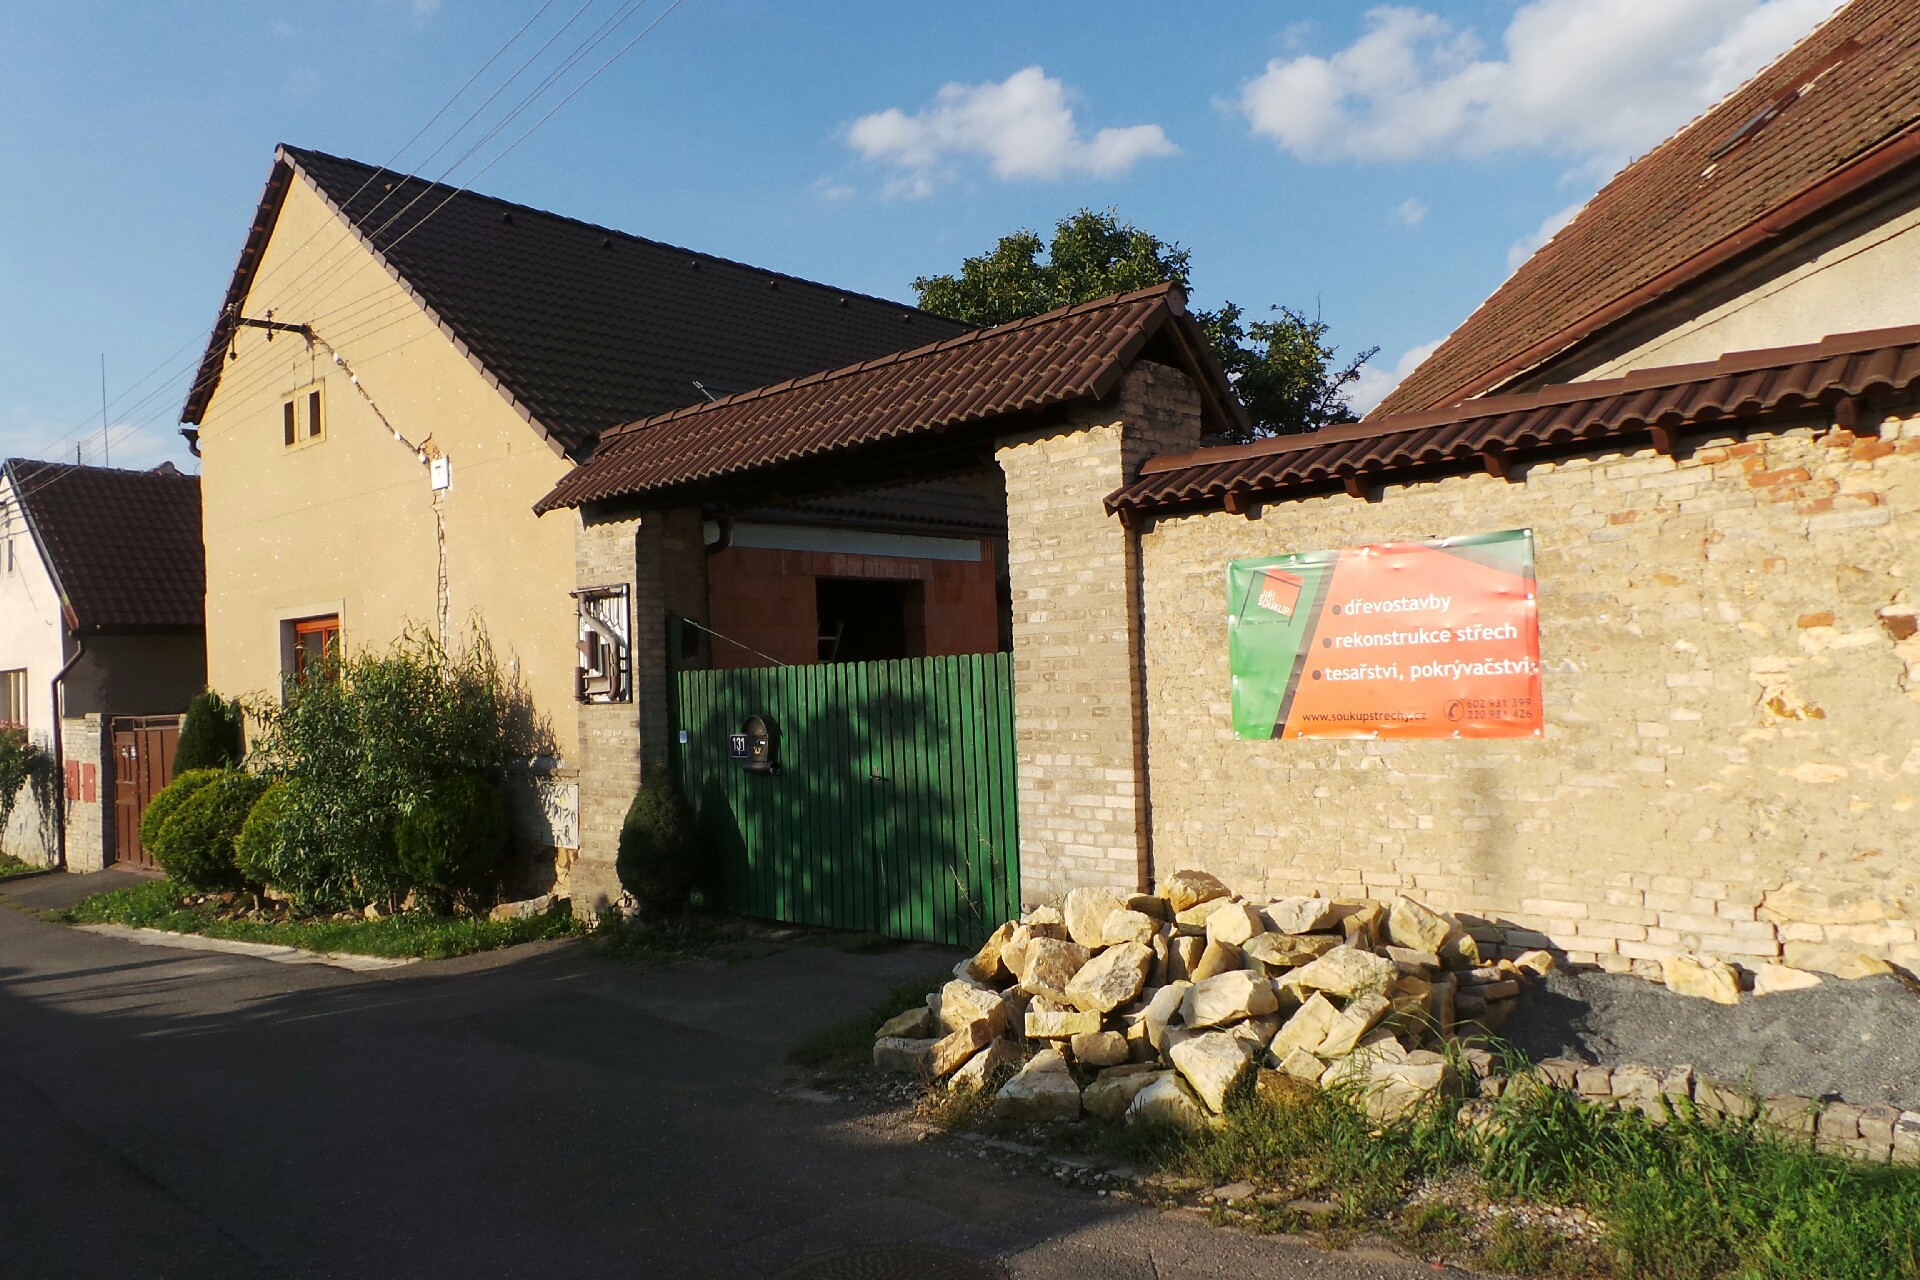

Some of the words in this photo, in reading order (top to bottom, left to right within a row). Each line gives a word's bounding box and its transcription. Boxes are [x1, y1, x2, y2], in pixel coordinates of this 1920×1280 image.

[1257, 597, 1290, 615] SOUKUP
[1344, 593, 1451, 616] dřevostavby
[1335, 627, 1451, 648] rekonstrukce
[1456, 622, 1518, 641] střech
[1324, 661, 1404, 681] tesařství,
[1411, 656, 1529, 681] pokrývačství
[1467, 699, 1485, 708] 602
[1302, 710, 1428, 723] www.soukupstrechy.cz
[1468, 709, 1486, 719] 220
[732, 737, 745, 750] 131
